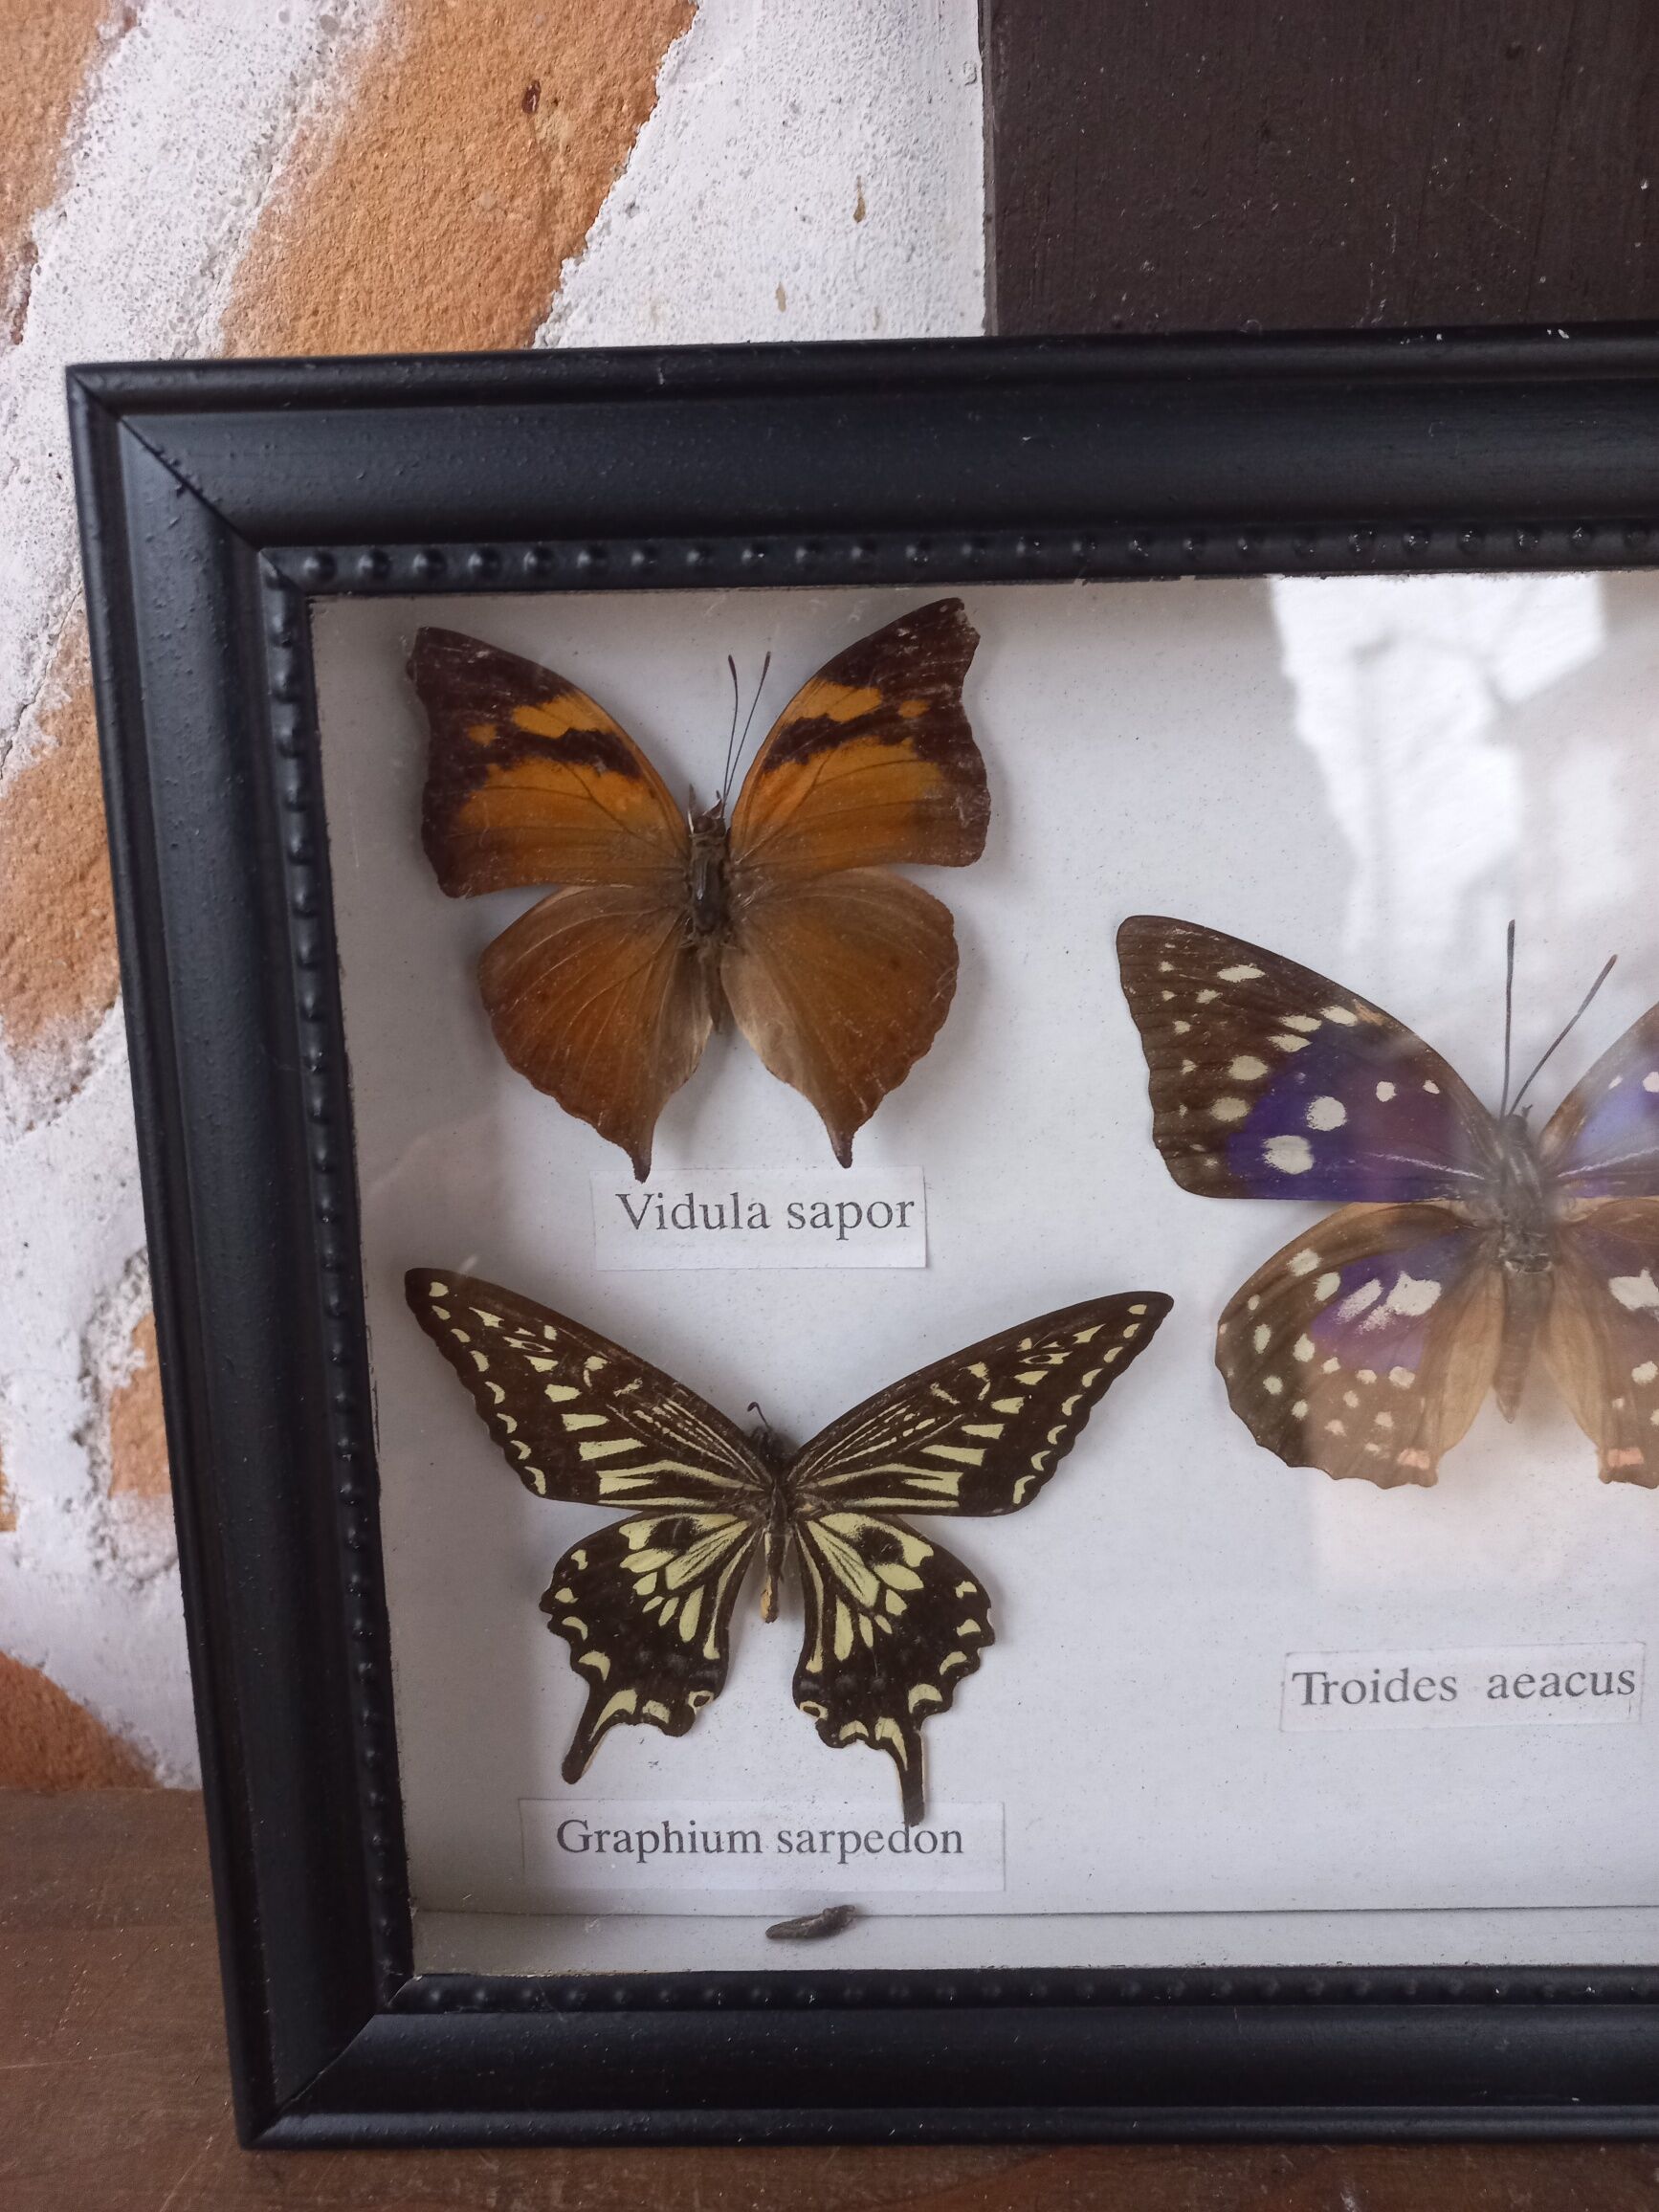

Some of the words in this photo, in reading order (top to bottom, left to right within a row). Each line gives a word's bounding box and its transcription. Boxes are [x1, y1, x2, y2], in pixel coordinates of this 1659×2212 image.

[615, 1192, 771, 1230] Vidula
[786, 1200, 916, 1241] sapor
[1292, 1667, 1458, 1706] Troides
[1486, 1668, 1636, 1700] aeacus
[556, 1819, 764, 1864] Graphium
[776, 1822, 964, 1865] sarpedon
